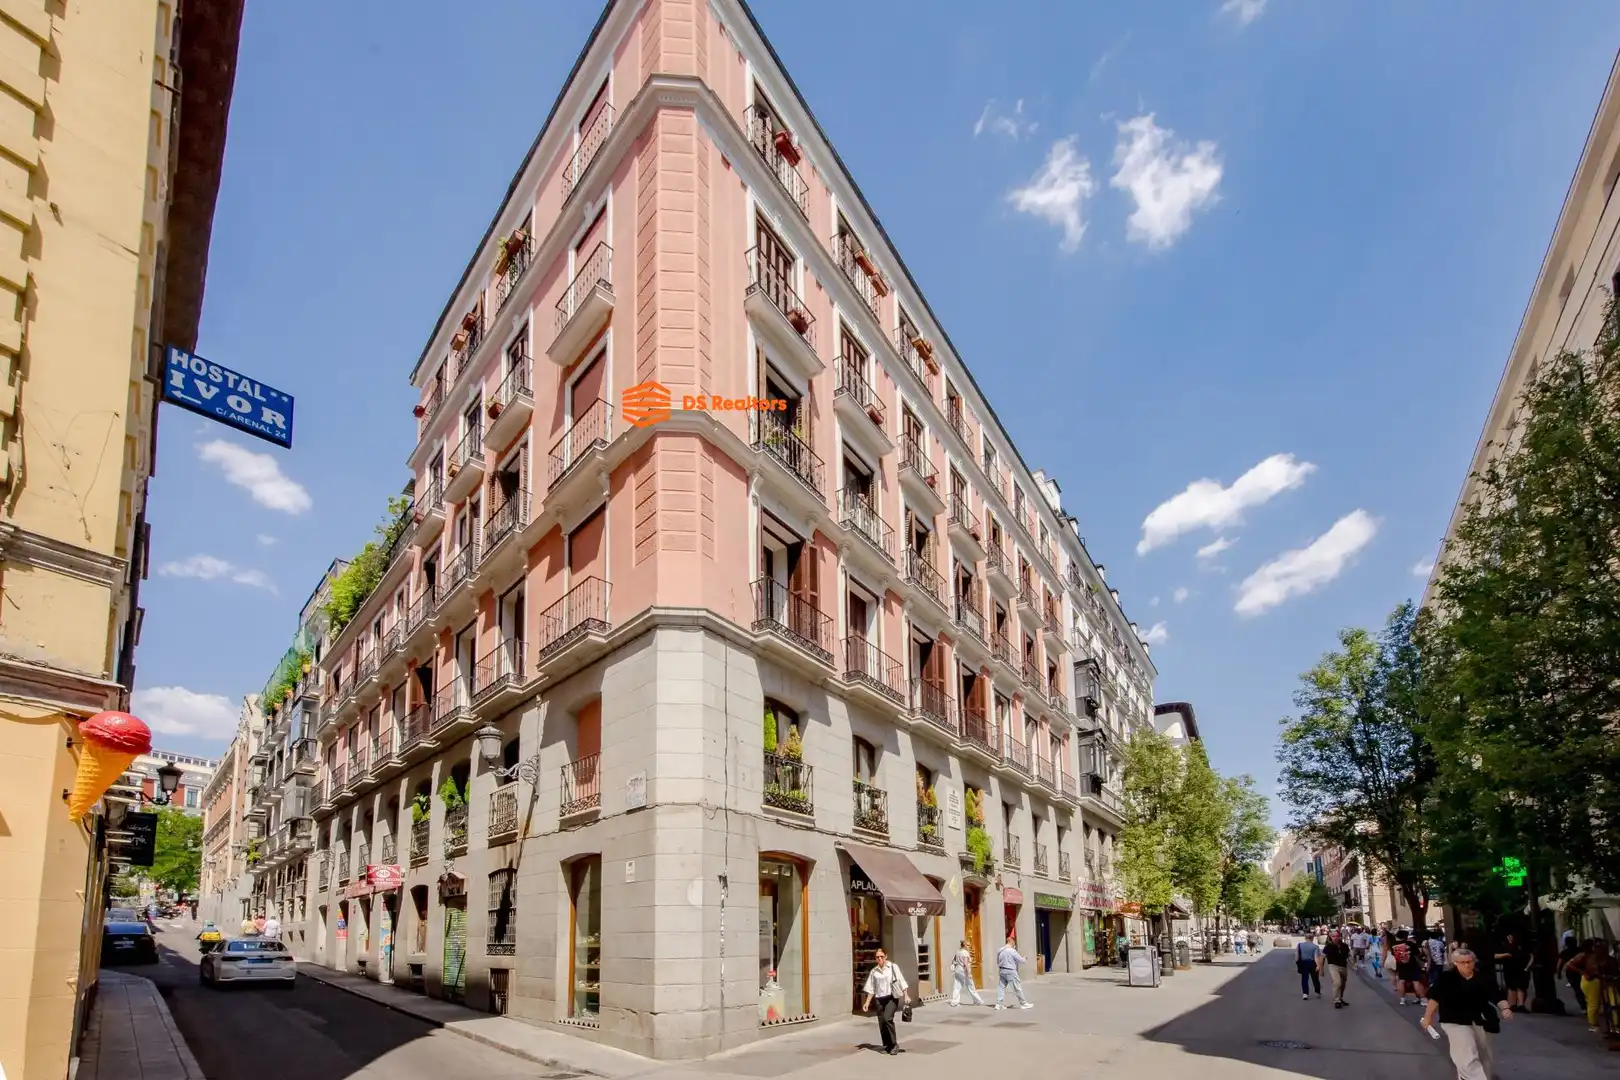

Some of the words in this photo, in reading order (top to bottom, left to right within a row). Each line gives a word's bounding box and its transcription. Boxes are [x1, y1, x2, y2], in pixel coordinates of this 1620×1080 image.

[170, 369, 286, 430] IVOR
[172, 348, 266, 402] HOSTAL
[229, 412, 272, 434] ARENAL
[275, 430, 286, 439] 24
